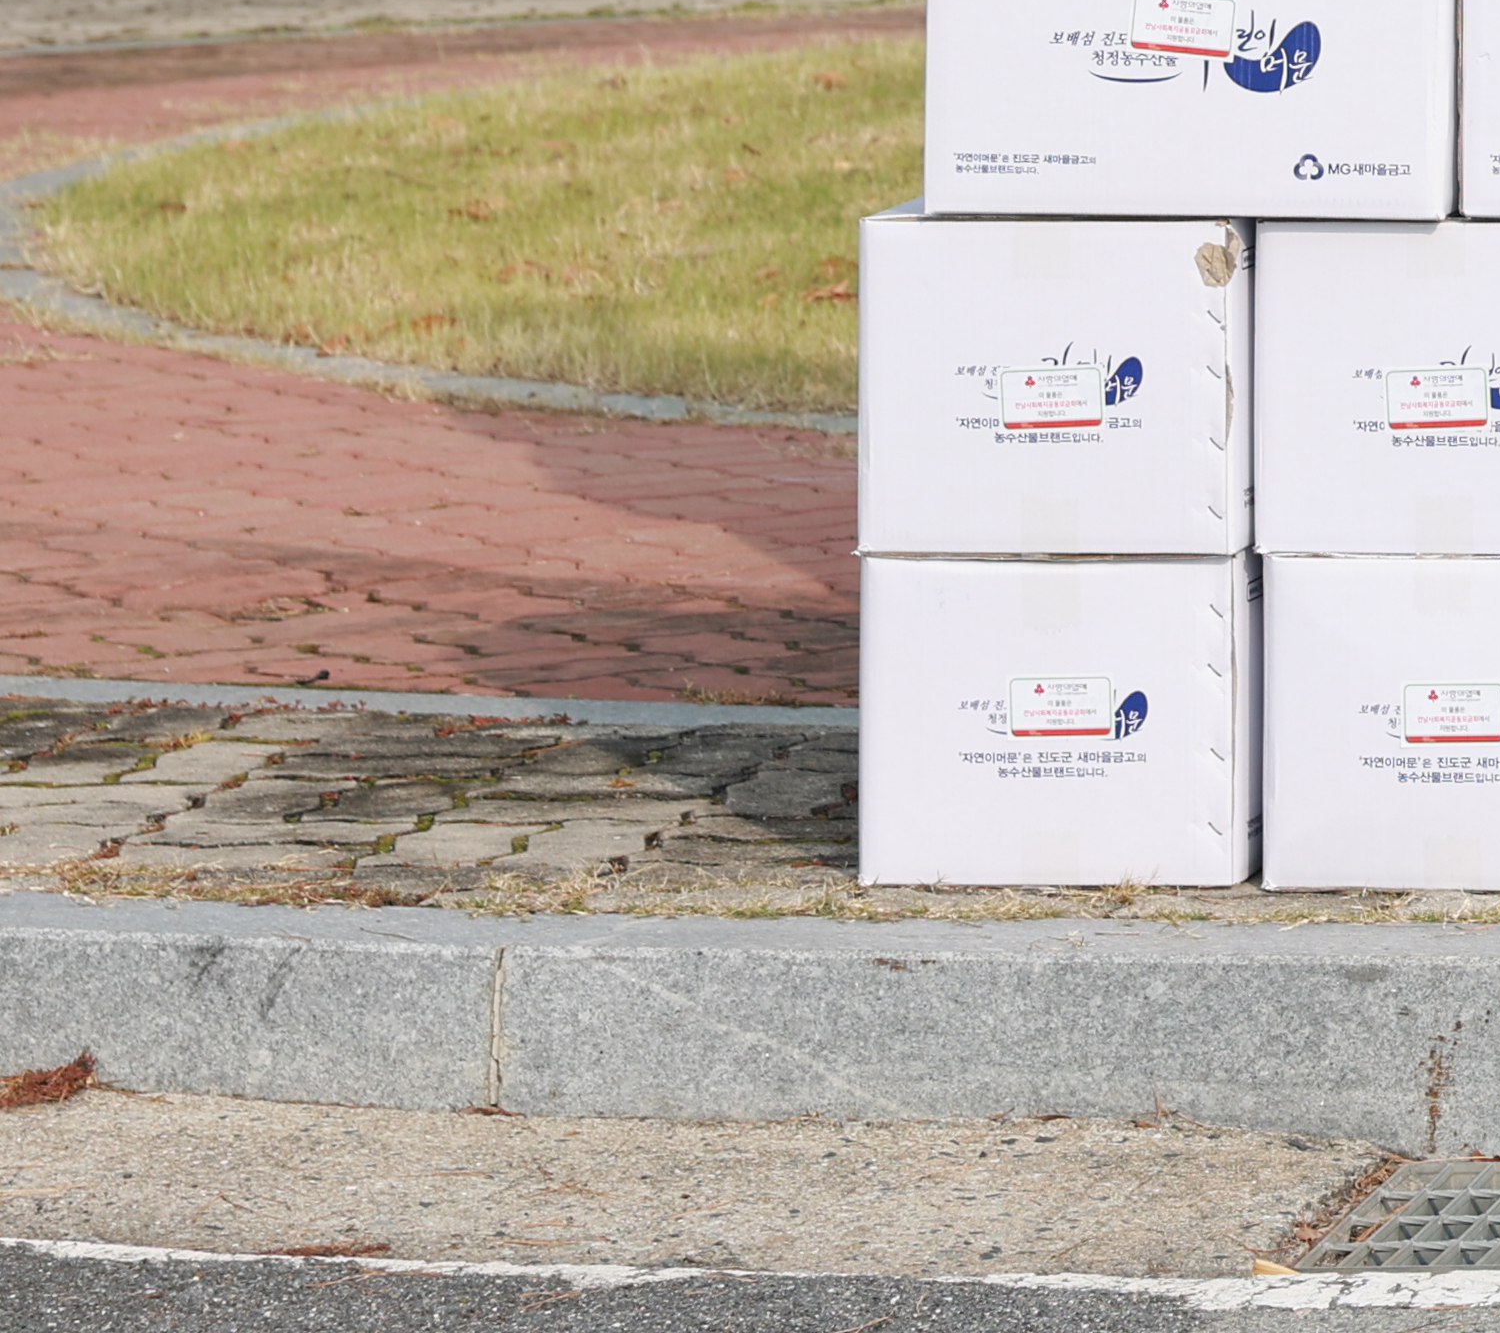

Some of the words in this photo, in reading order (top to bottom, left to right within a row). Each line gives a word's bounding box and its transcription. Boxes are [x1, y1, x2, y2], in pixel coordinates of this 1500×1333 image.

[1050, 31, 1095, 45] 보배섬
[1102, 32, 1127, 46] 진도
[1013, 153, 1040, 164] 진도군
[1043, 154, 1097, 165] 새마을금고의
[956, 163, 1036, 173] 농수산물브랜드입니다.
[995, 432, 1101, 443] 농수산물브랜드입니다.
[1392, 436, 1500, 447] 농수산물브랜드입니다.
[1038, 752, 1072, 763] 진도군
[1077, 751, 1146, 765] 새마을금고의
[1437, 757, 1472, 770] 진도군
[998, 767, 1104, 777] 농수산물브랜드입니다.
